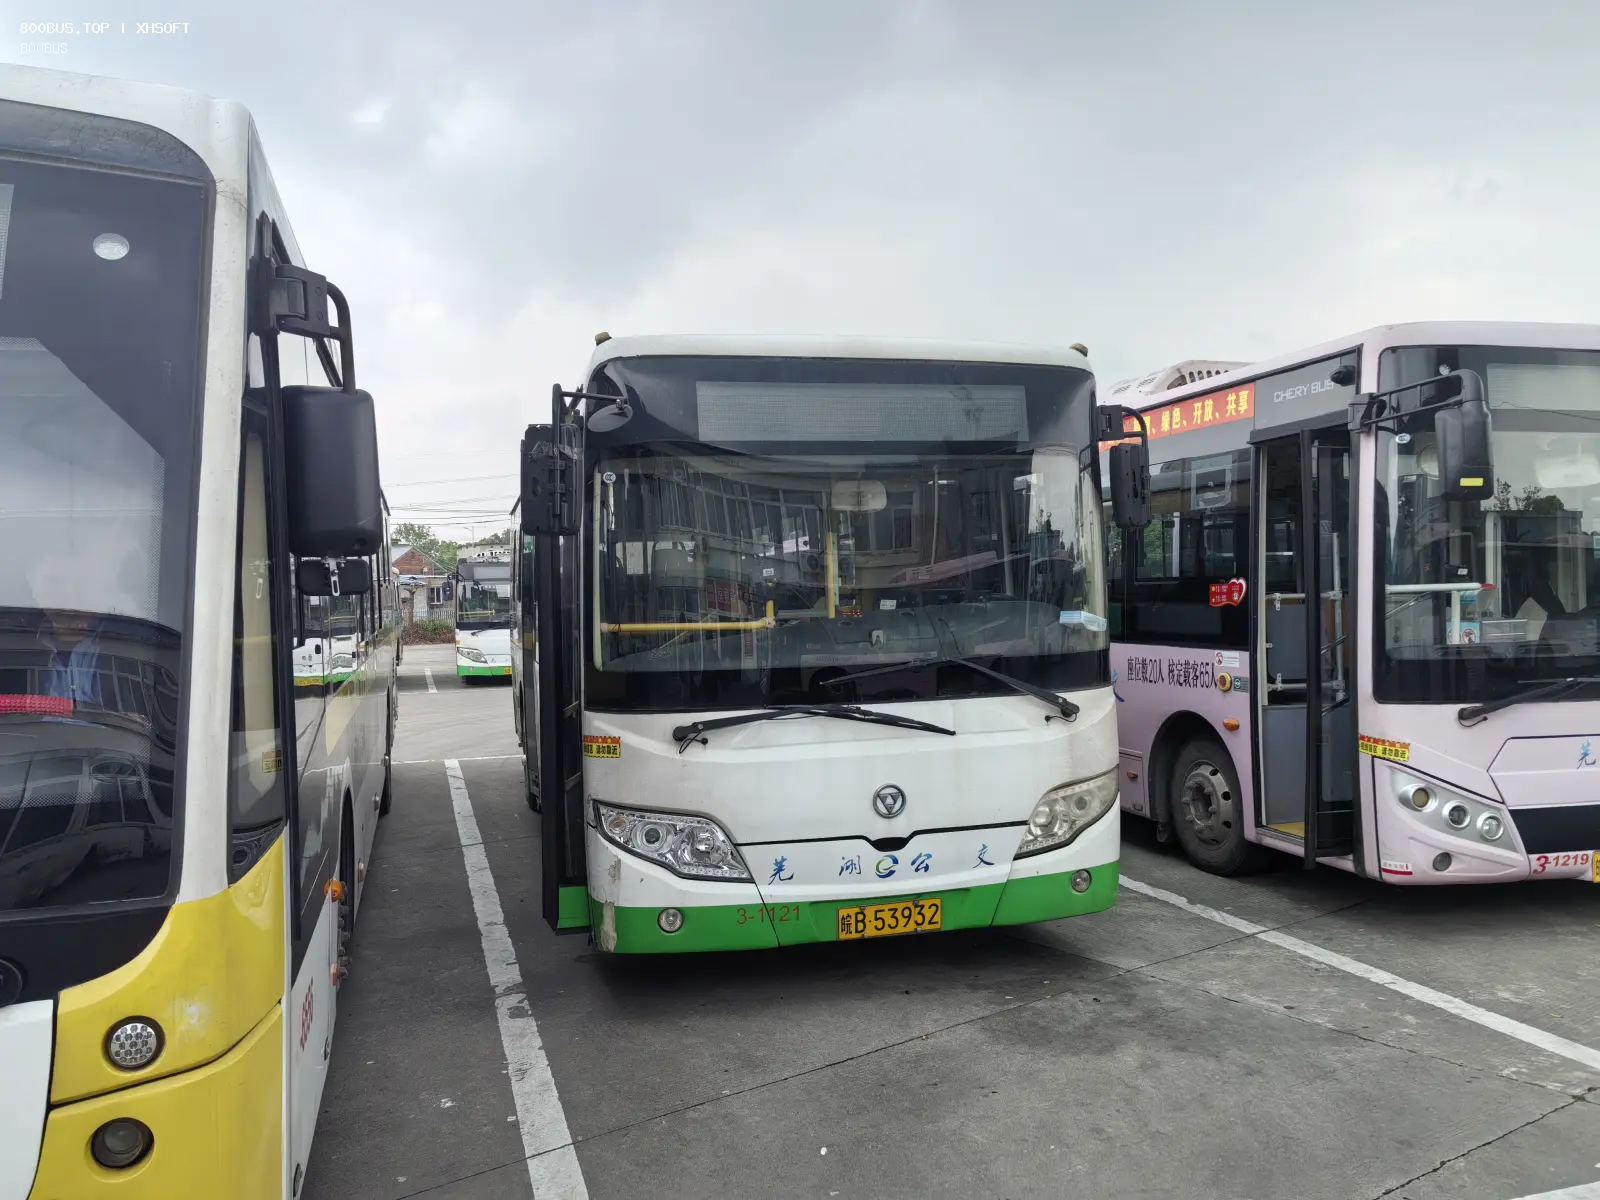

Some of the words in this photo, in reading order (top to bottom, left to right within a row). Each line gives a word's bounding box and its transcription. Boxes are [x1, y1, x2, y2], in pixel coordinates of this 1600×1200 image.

[1273, 383, 1310, 403] CHERY
[1311, 379, 1334, 394] BUS
[1532, 854, 1590, 875] 3-1219
[736, 905, 801, 925] 3-1121
